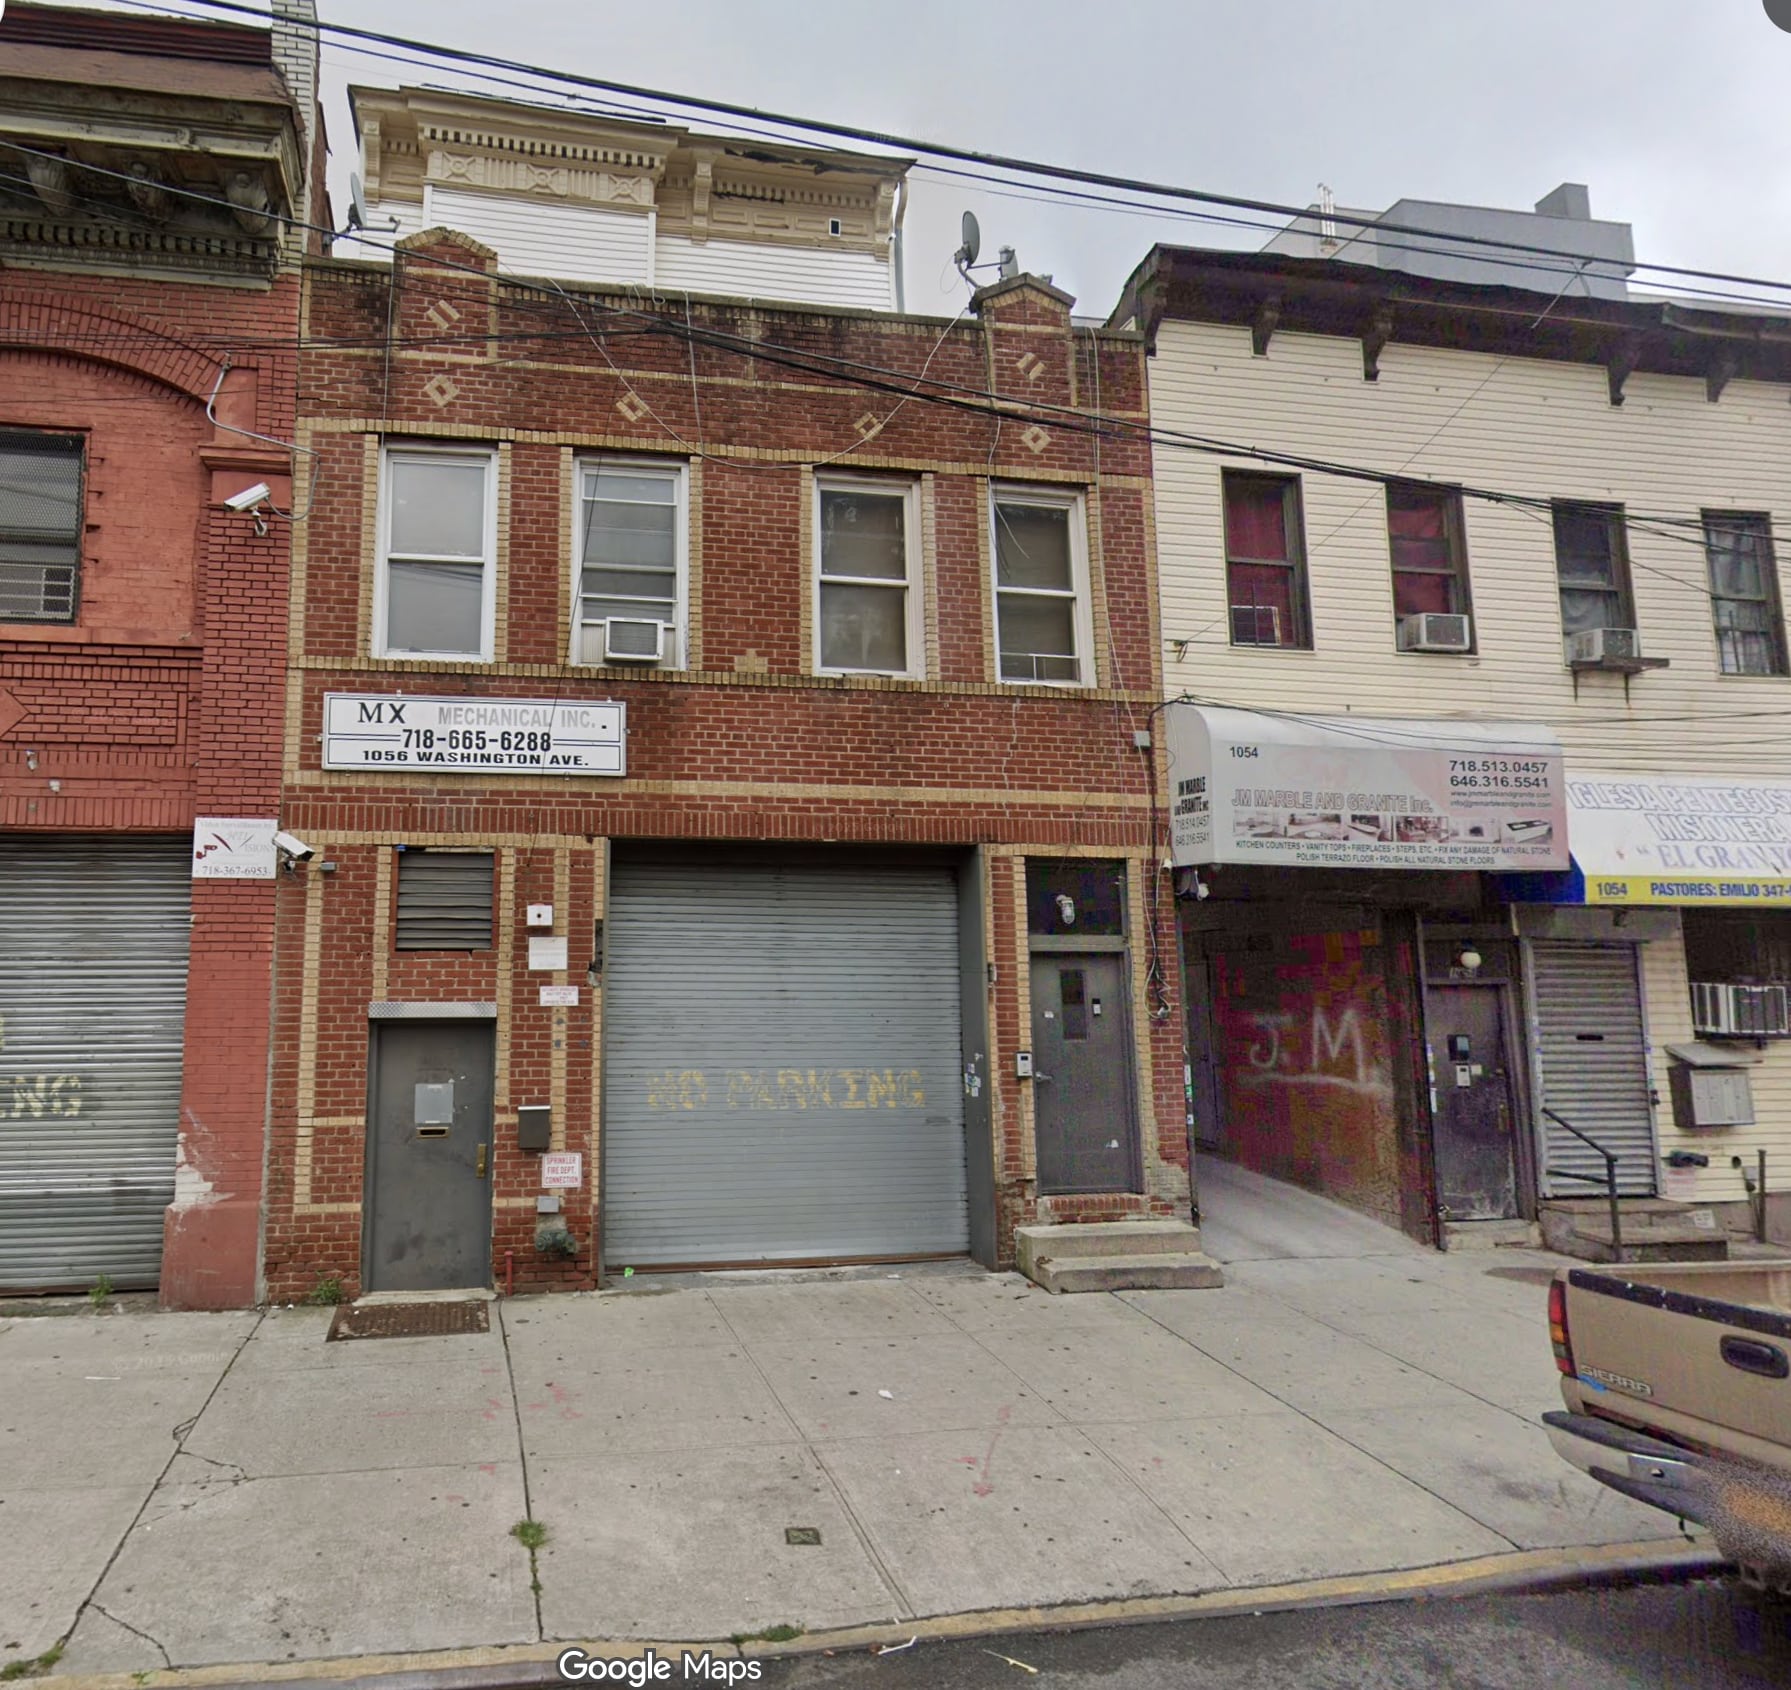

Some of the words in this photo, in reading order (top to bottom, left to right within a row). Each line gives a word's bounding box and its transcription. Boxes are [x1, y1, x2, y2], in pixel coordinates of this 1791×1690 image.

[358, 702, 406, 724] MX
[438, 706, 551, 727] MECHANICAL
[402, 729, 551, 751] 718-665-6288
[362, 750, 408, 762] 1056
[417, 751, 541, 765] WASHINGTON
[549, 754, 589, 766] AVE.
[1230, 746, 1258, 758] 1054
[1449, 760, 1548, 773] 718.513.0457
[1449, 776, 1549, 788] 646.316.5541
[1231, 788, 1252, 807] JM
[1254, 789, 1313, 809] MARBLE
[1315, 792, 1345, 810] AND
[1347, 793, 1409, 812] GRANITE
[1410, 795, 1433, 813] Inc.
[1565, 782, 1669, 811] IGLESIA
[1658, 785, 1791, 814] PENTECOS
[1644, 813, 1791, 843] MISIONERA
[1236, 840, 1265, 849] KITCHEN
[1266, 841, 1301, 850] COUNTERS
[1306, 842, 1328, 851] VANITY
[202, 866, 268, 876] 718-367-6953
[1597, 882, 1628, 896] 1054
[1650, 882, 1717, 897] PASTORES:
[1719, 883, 1759, 897] EMILIO
[647, 1070, 707, 1110] NO
[727, 1067, 926, 1110] PARKING
[1579, 1364, 1653, 1396] SIERRA
